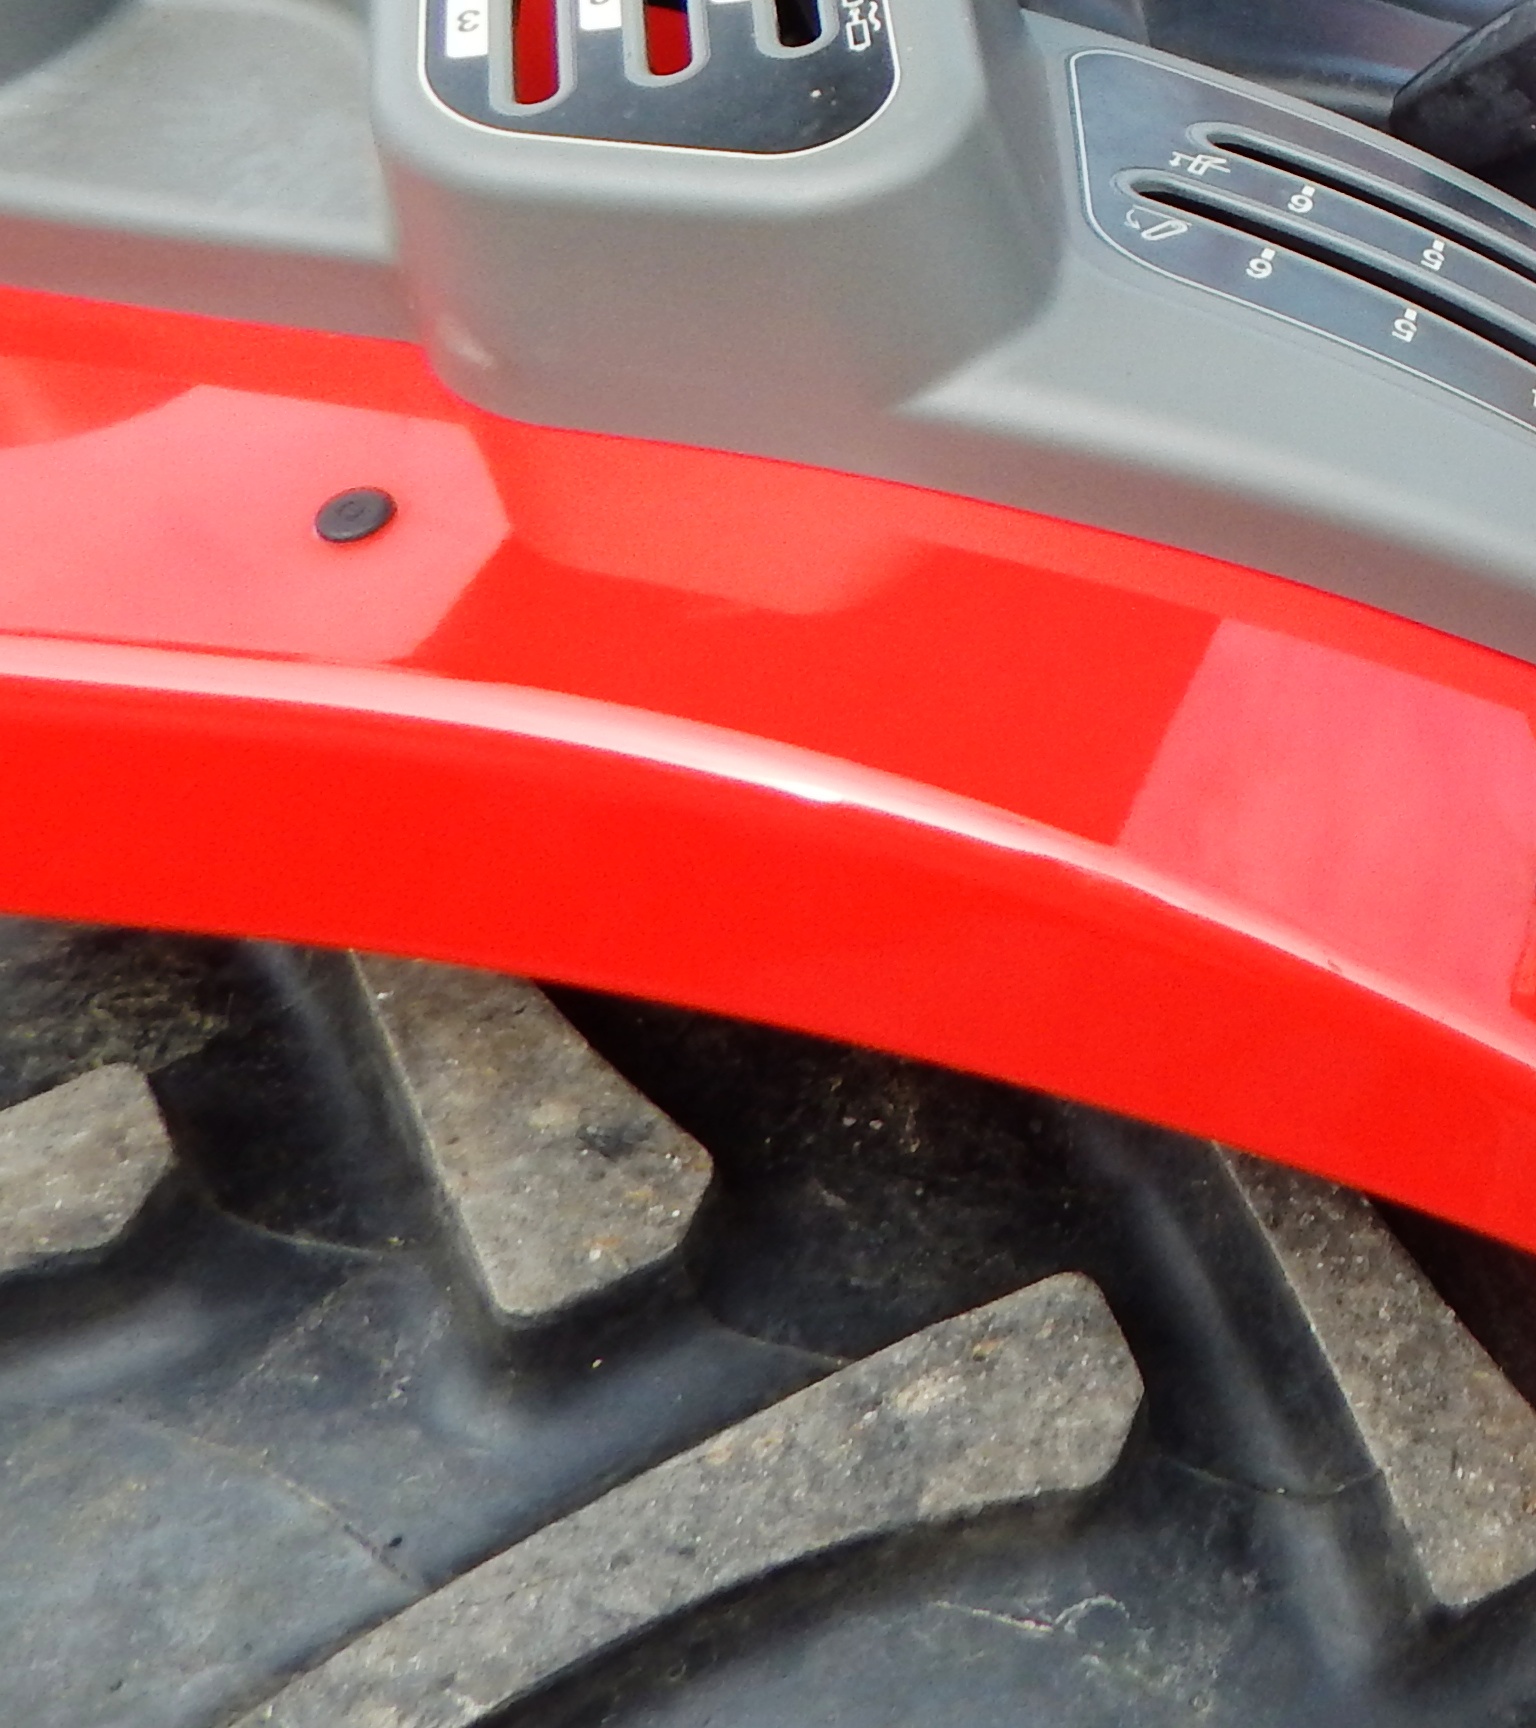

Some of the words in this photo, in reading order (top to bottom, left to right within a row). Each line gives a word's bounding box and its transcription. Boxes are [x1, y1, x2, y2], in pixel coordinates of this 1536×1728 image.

[456, 9, 481, 33] 3
[1287, 193, 1314, 214] 6
[1245, 257, 1273, 279] 6
[1420, 248, 1446, 272] 5
[1391, 317, 1418, 343] 5
